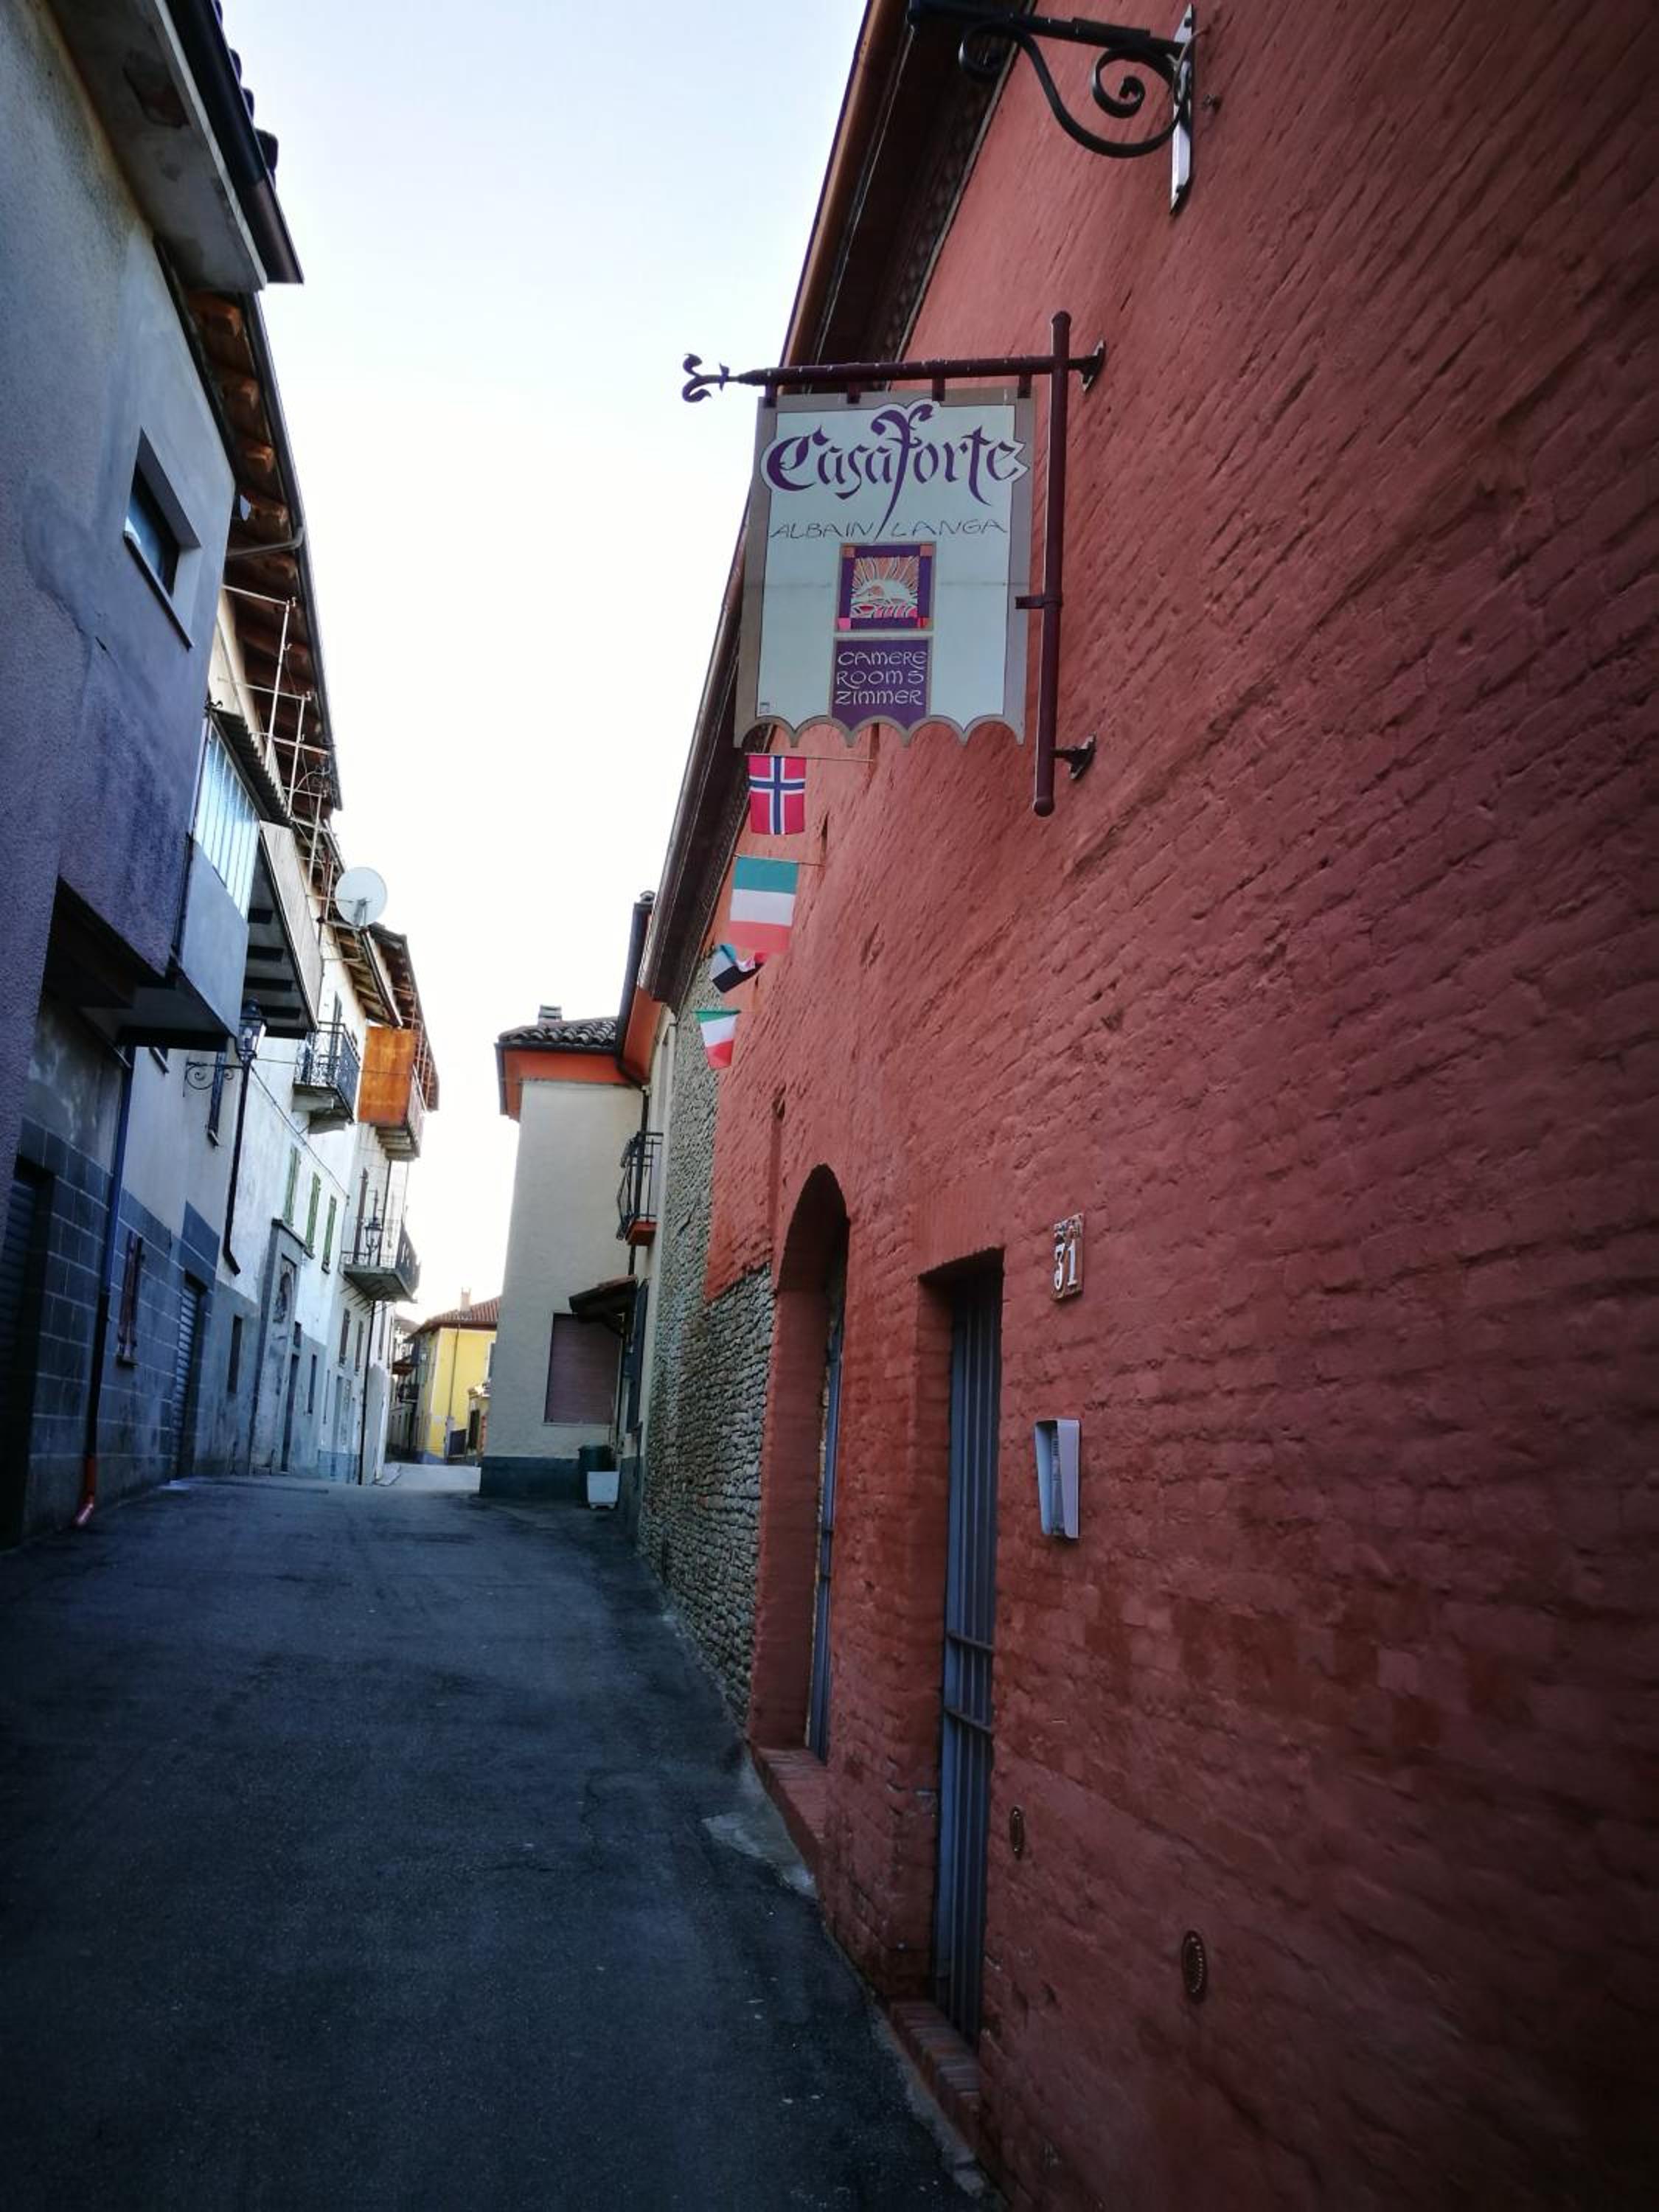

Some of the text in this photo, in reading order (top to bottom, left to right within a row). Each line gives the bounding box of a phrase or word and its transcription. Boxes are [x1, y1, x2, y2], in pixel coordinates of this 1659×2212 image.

[891, 518, 1008, 538] LANGA
[838, 651, 928, 670] CAMERE
[837, 670, 925, 689] ROOMS
[835, 689, 923, 706] ZIMMER
